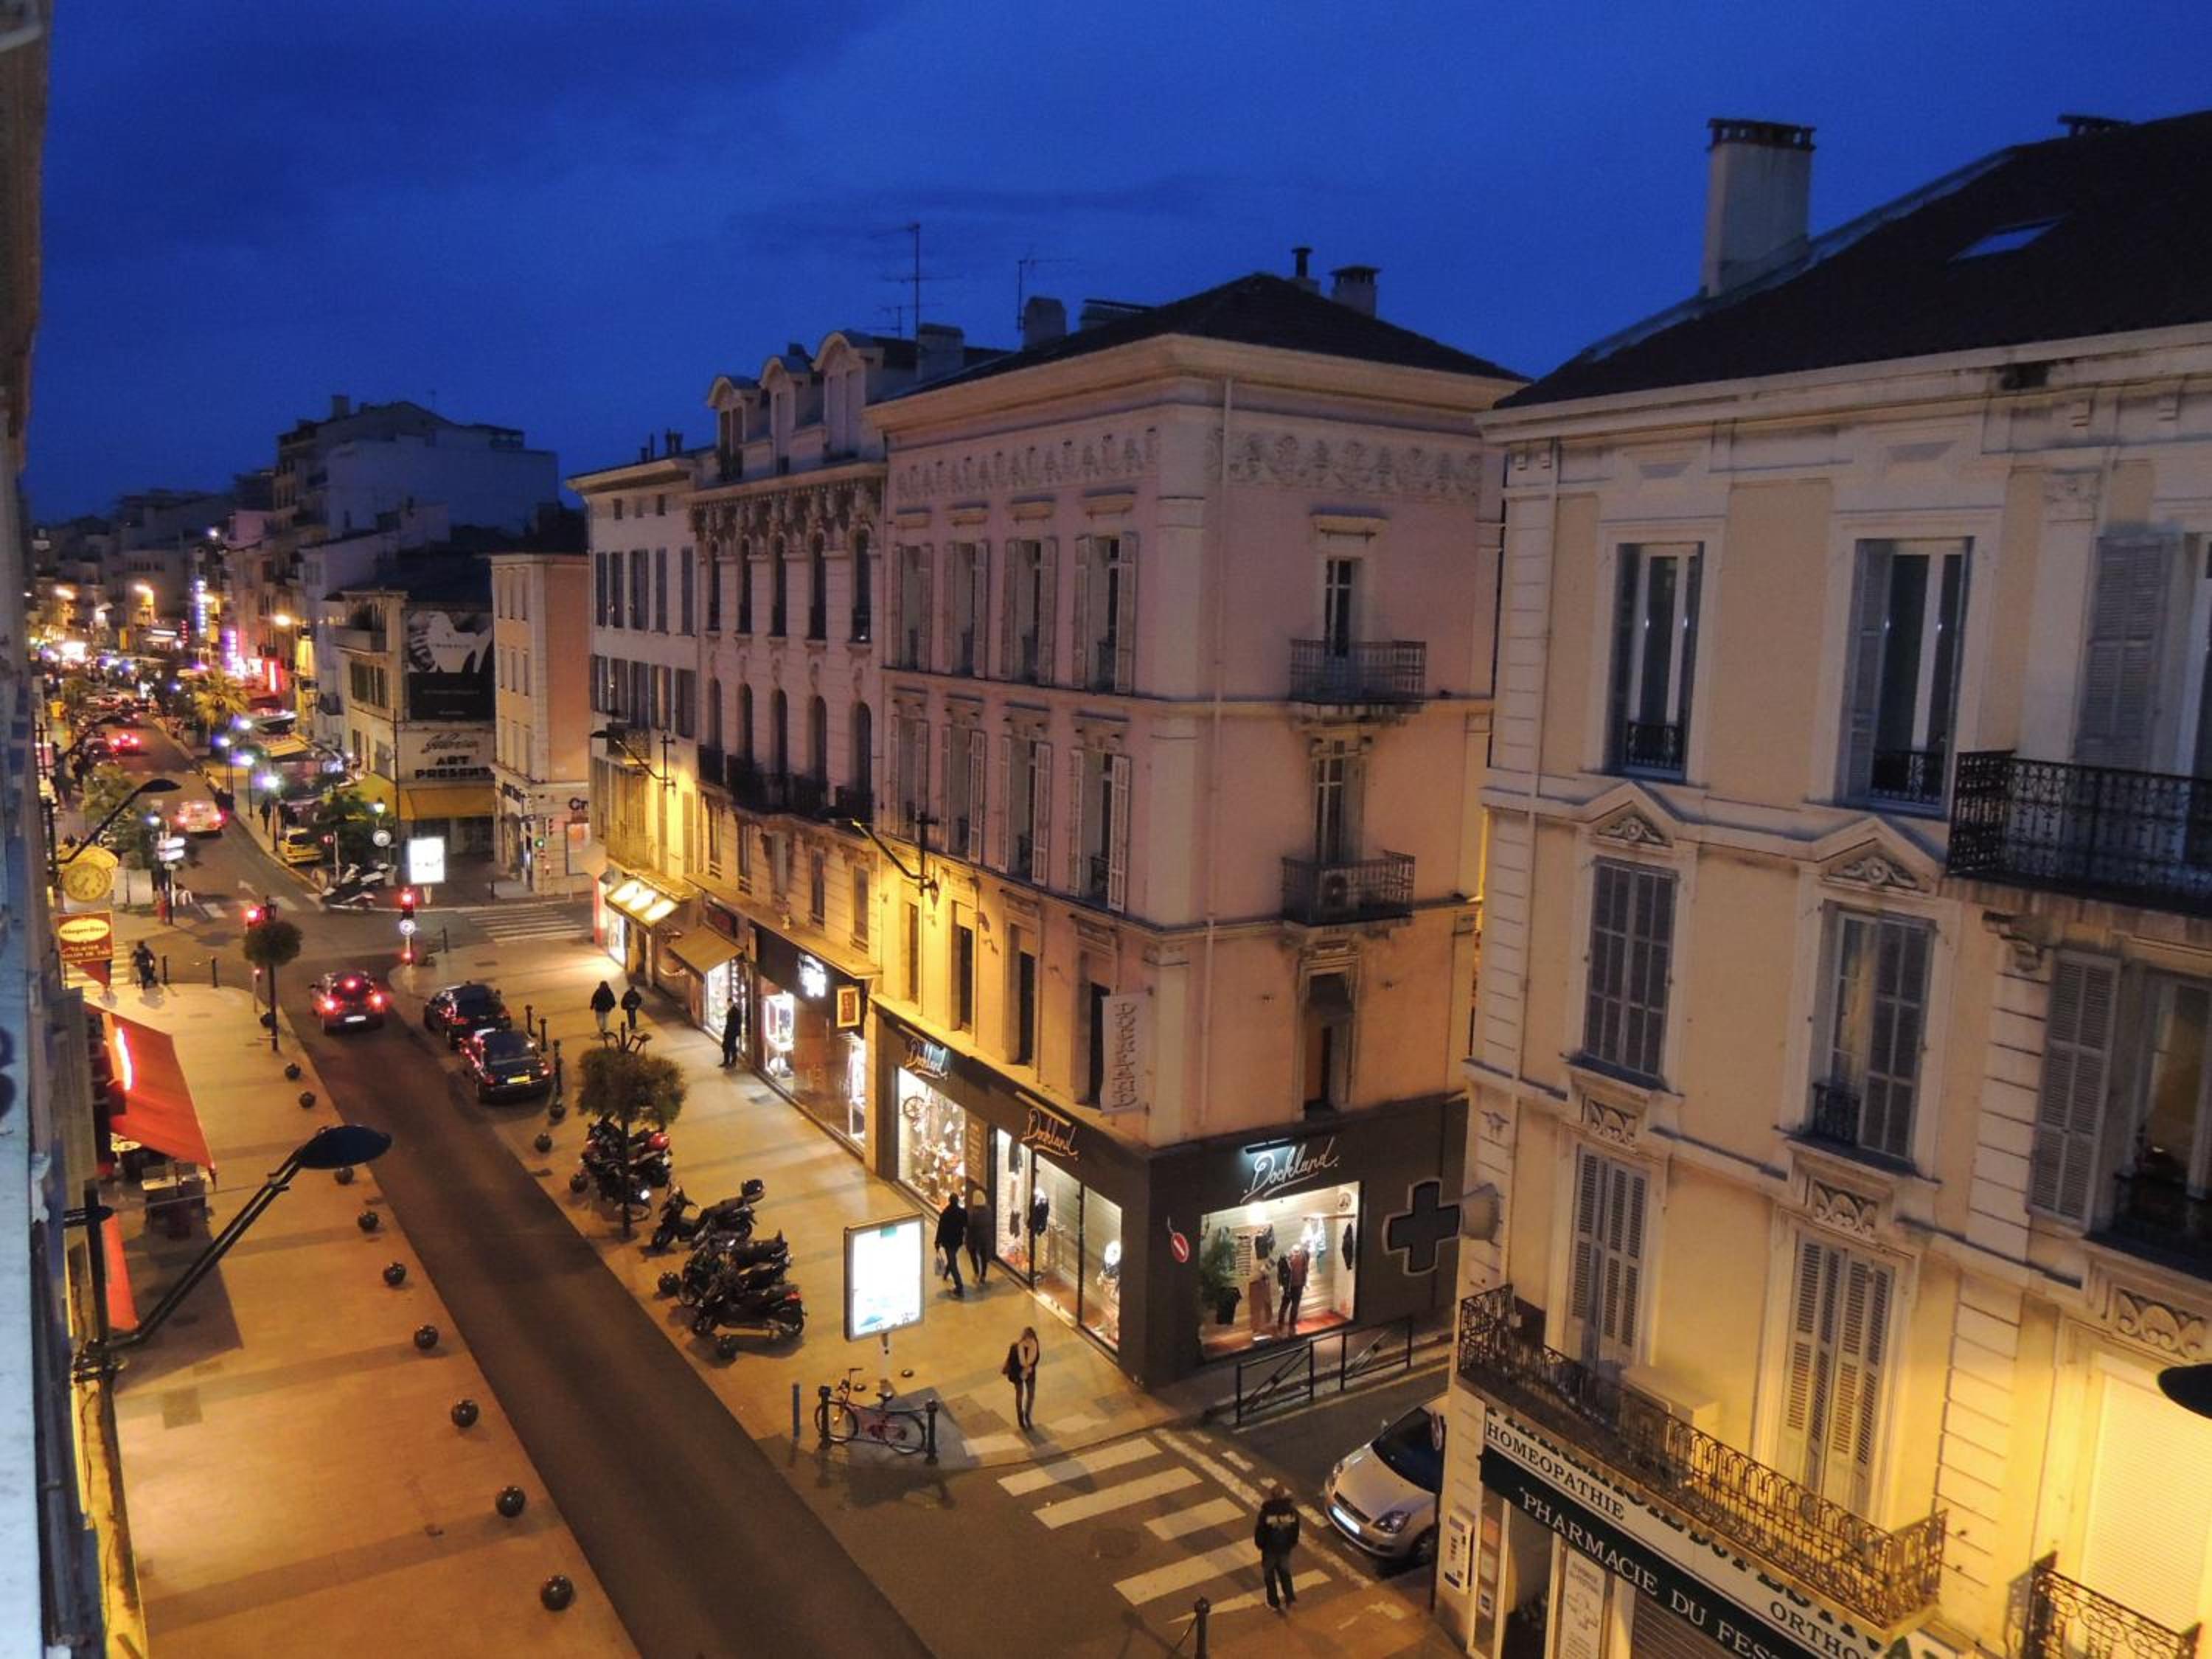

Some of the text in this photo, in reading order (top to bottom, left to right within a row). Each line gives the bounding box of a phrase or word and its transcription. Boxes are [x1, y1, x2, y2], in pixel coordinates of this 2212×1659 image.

[1021, 1108, 1079, 1157] Dockland
[1239, 1135, 1340, 1204] Dockland
[1485, 1421, 1625, 1520] HOMEOPATHIE
[1522, 1492, 1659, 1596] PHARMACIE
[1669, 1588, 1707, 1627] DU
[1717, 1618, 1781, 1659] FES
[1770, 1601, 1868, 1659] ORTHO
